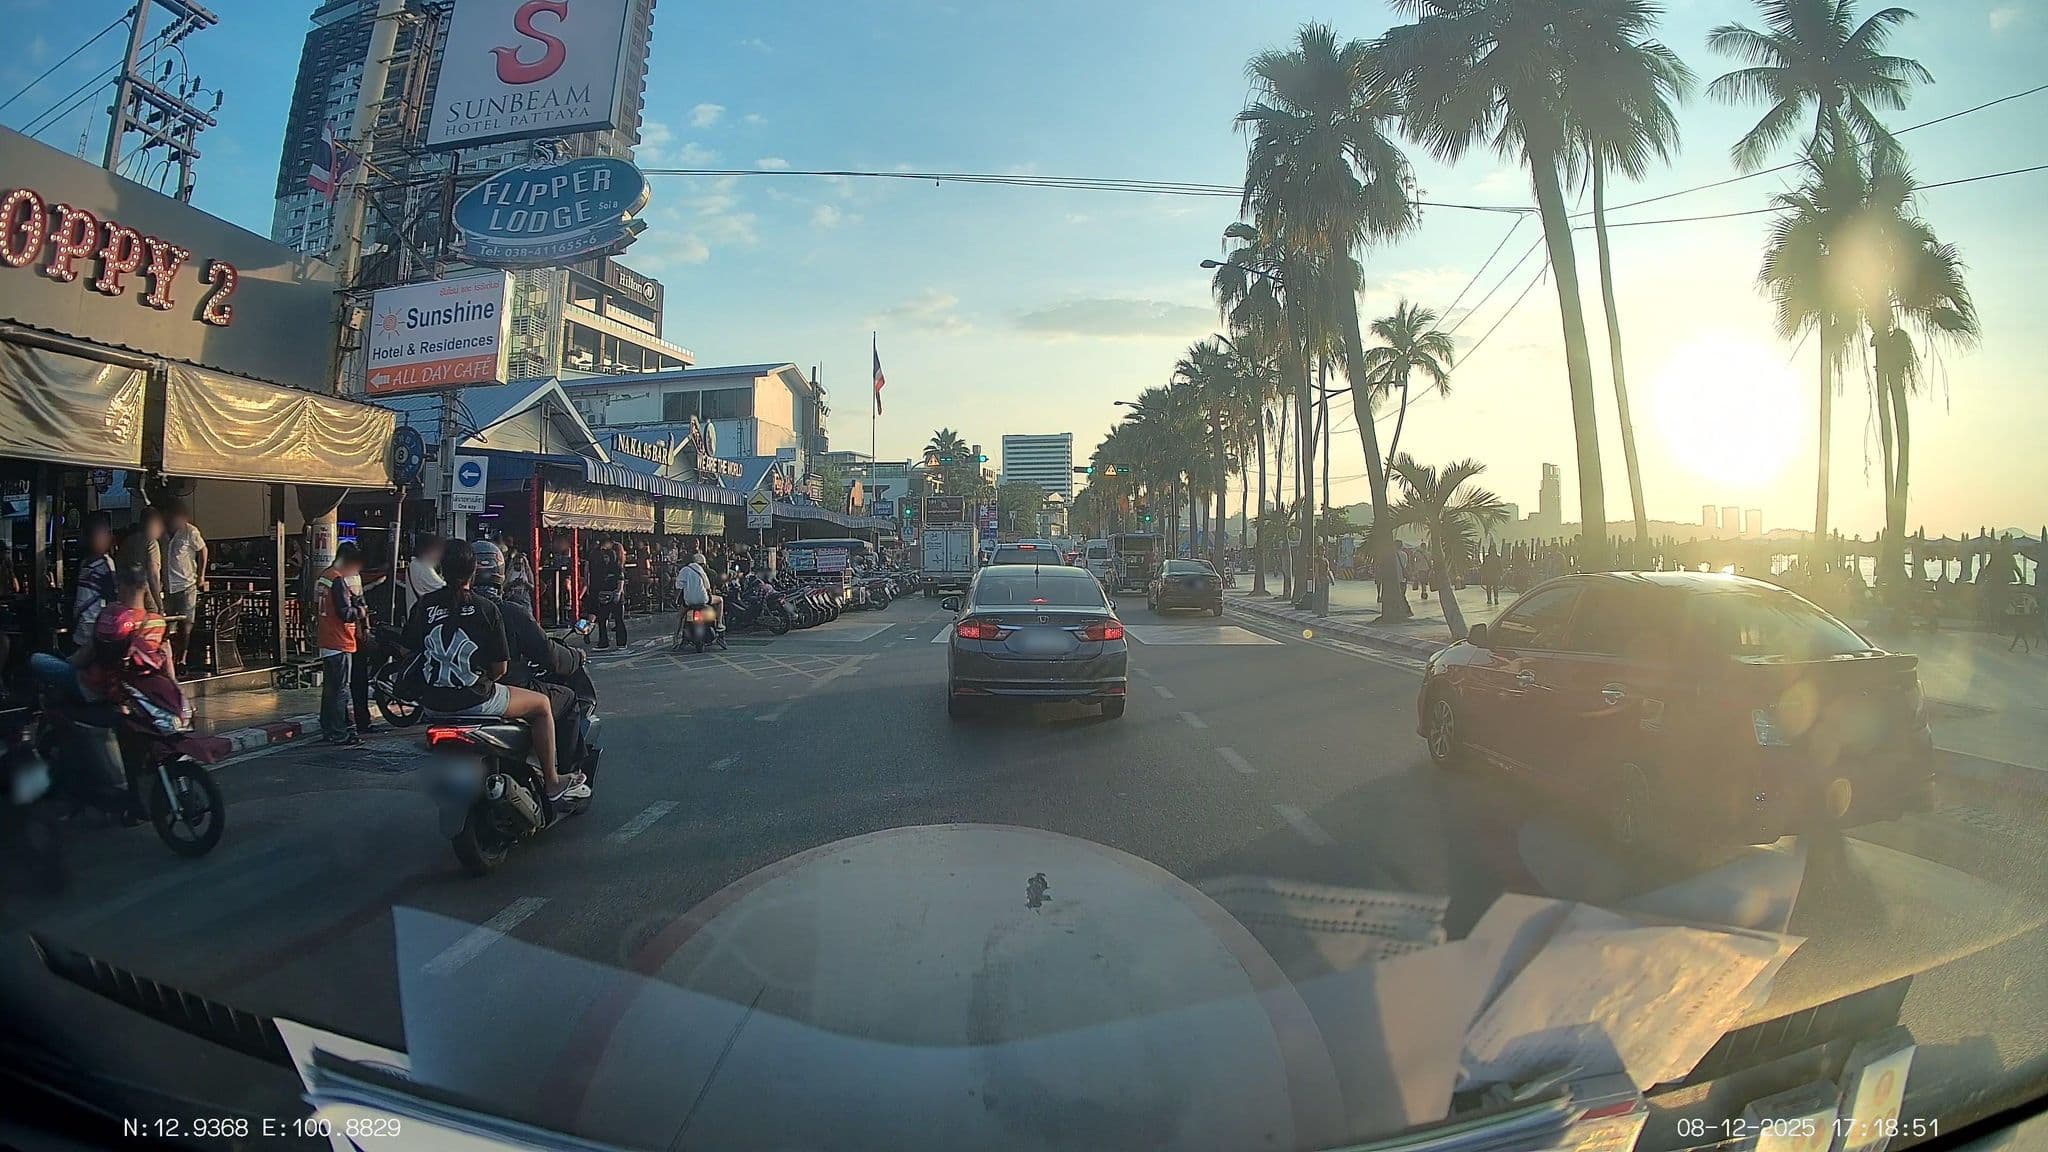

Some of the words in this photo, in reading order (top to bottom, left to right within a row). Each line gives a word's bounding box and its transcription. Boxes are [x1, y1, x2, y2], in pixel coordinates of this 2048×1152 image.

[447, 83, 591, 123] SUNBEAM
[445, 120, 500, 136] HOTEL
[510, 107, 589, 126] PATTAYA
[482, 168, 612, 206] FLIPPER
[489, 199, 592, 233] LODGE
[598, 202, 612, 210] Soi
[612, 201, 618, 209] 8
[480, 245, 500, 256] Tel:
[505, 235, 598, 257] 038-411655-6
[203, 260, 238, 326] 2
[620, 272, 642, 293] Hilton
[407, 300, 494, 329] Sunshine
[373, 345, 403, 360] Hotel
[407, 343, 416, 355] &
[420, 335, 493, 354] Residences
[392, 368, 417, 386] ALL
[422, 364, 451, 383] DAY
[454, 357, 491, 379] CAFÉ
[618, 433, 642, 458] NAKA
[643, 442, 652, 460] 95
[652, 445, 668, 465] BAR
[697, 454, 706, 470] WE
[706, 456, 718, 472] ARE
[718, 458, 727, 474] THE
[728, 461, 743, 477] WORLD
